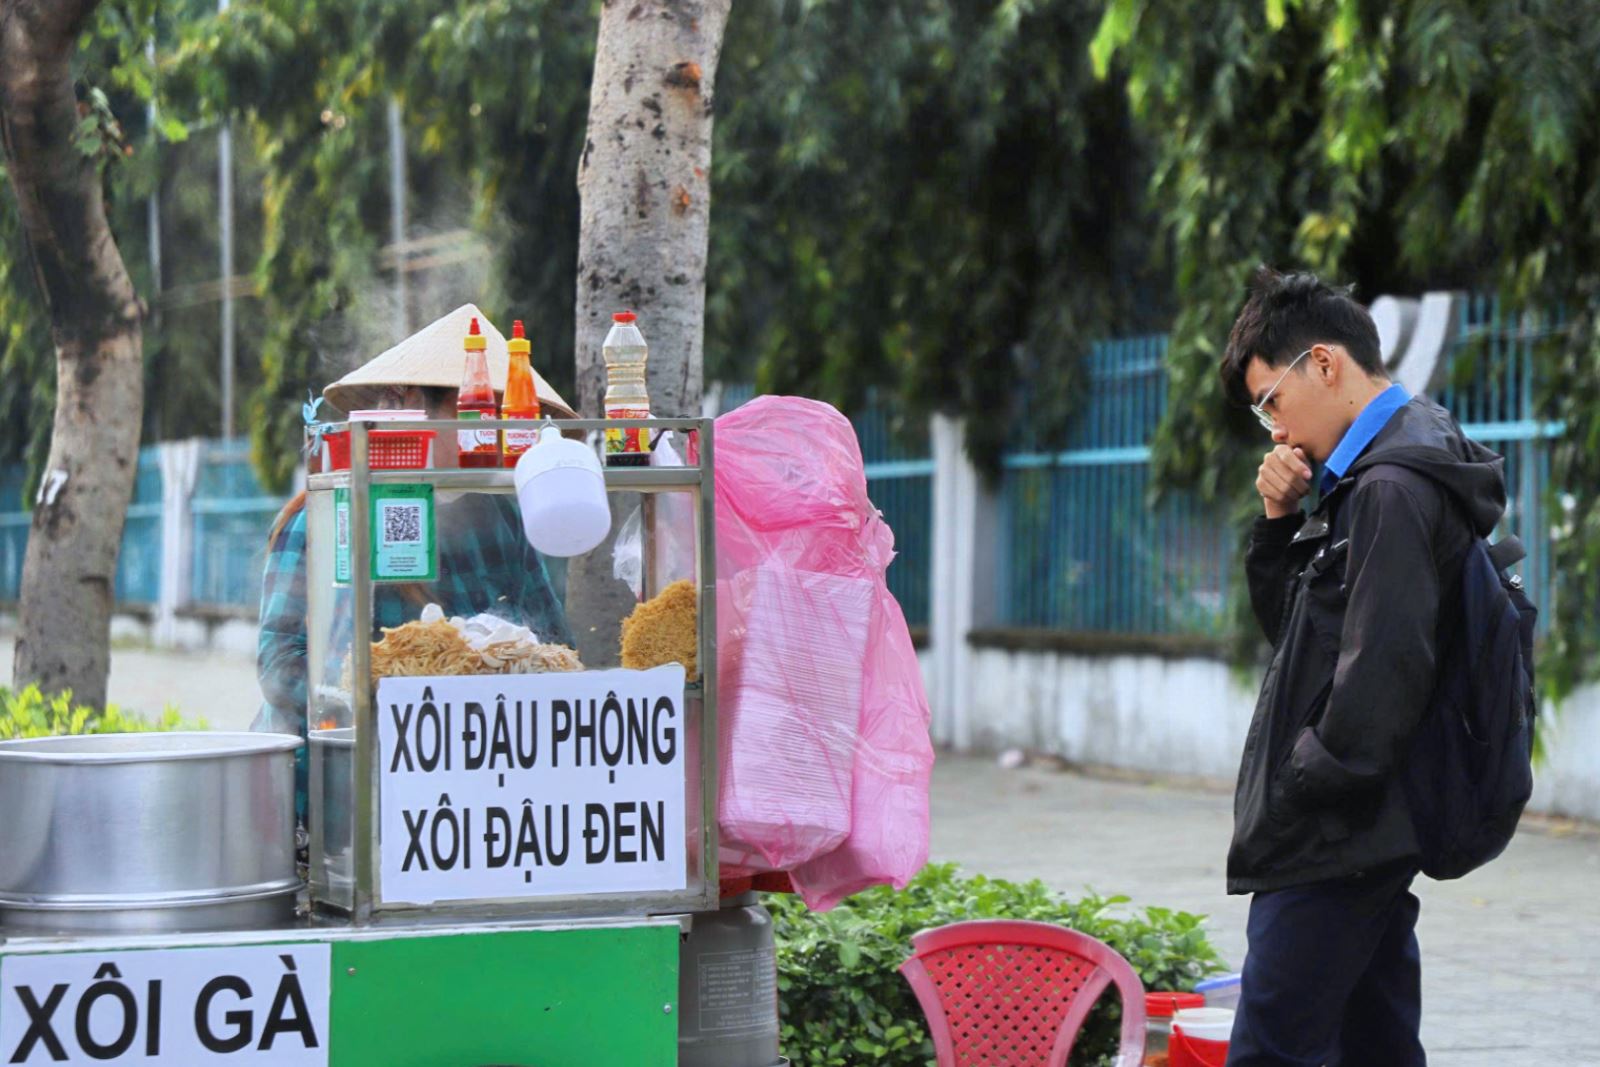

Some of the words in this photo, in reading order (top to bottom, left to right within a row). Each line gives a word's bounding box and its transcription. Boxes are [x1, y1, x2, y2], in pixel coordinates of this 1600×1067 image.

[390, 686, 451, 772] XÔI
[462, 693, 538, 787] ĐẬU
[551, 690, 676, 783] PHỘNG
[401, 793, 470, 872] XÔI
[484, 798, 570, 883] ĐẬU
[583, 801, 665, 864] ĐEN
[8, 962, 162, 1064] XÔI
[194, 954, 319, 1054] GÀ
